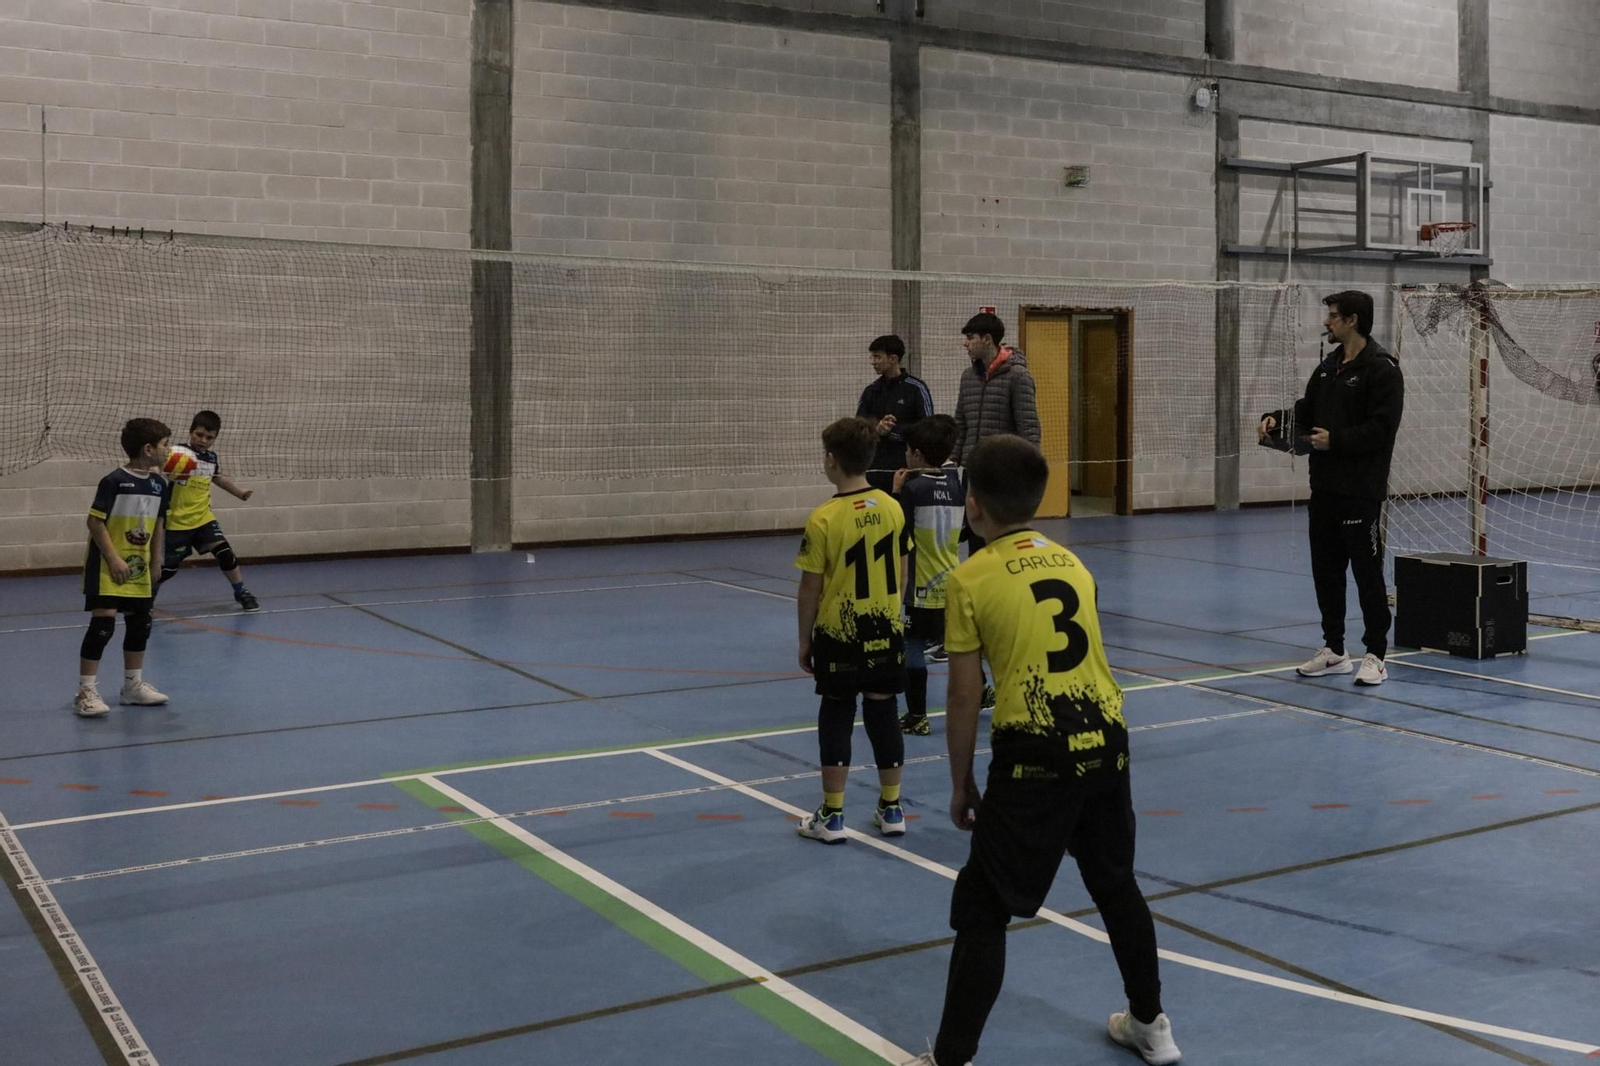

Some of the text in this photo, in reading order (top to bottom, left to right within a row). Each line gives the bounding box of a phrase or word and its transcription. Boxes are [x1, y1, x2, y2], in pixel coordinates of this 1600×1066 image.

[845, 530, 897, 600] 11
[1005, 553, 1075, 575] CARLOS
[1029, 578, 1089, 673] 3
[1067, 728, 1106, 752] NON
